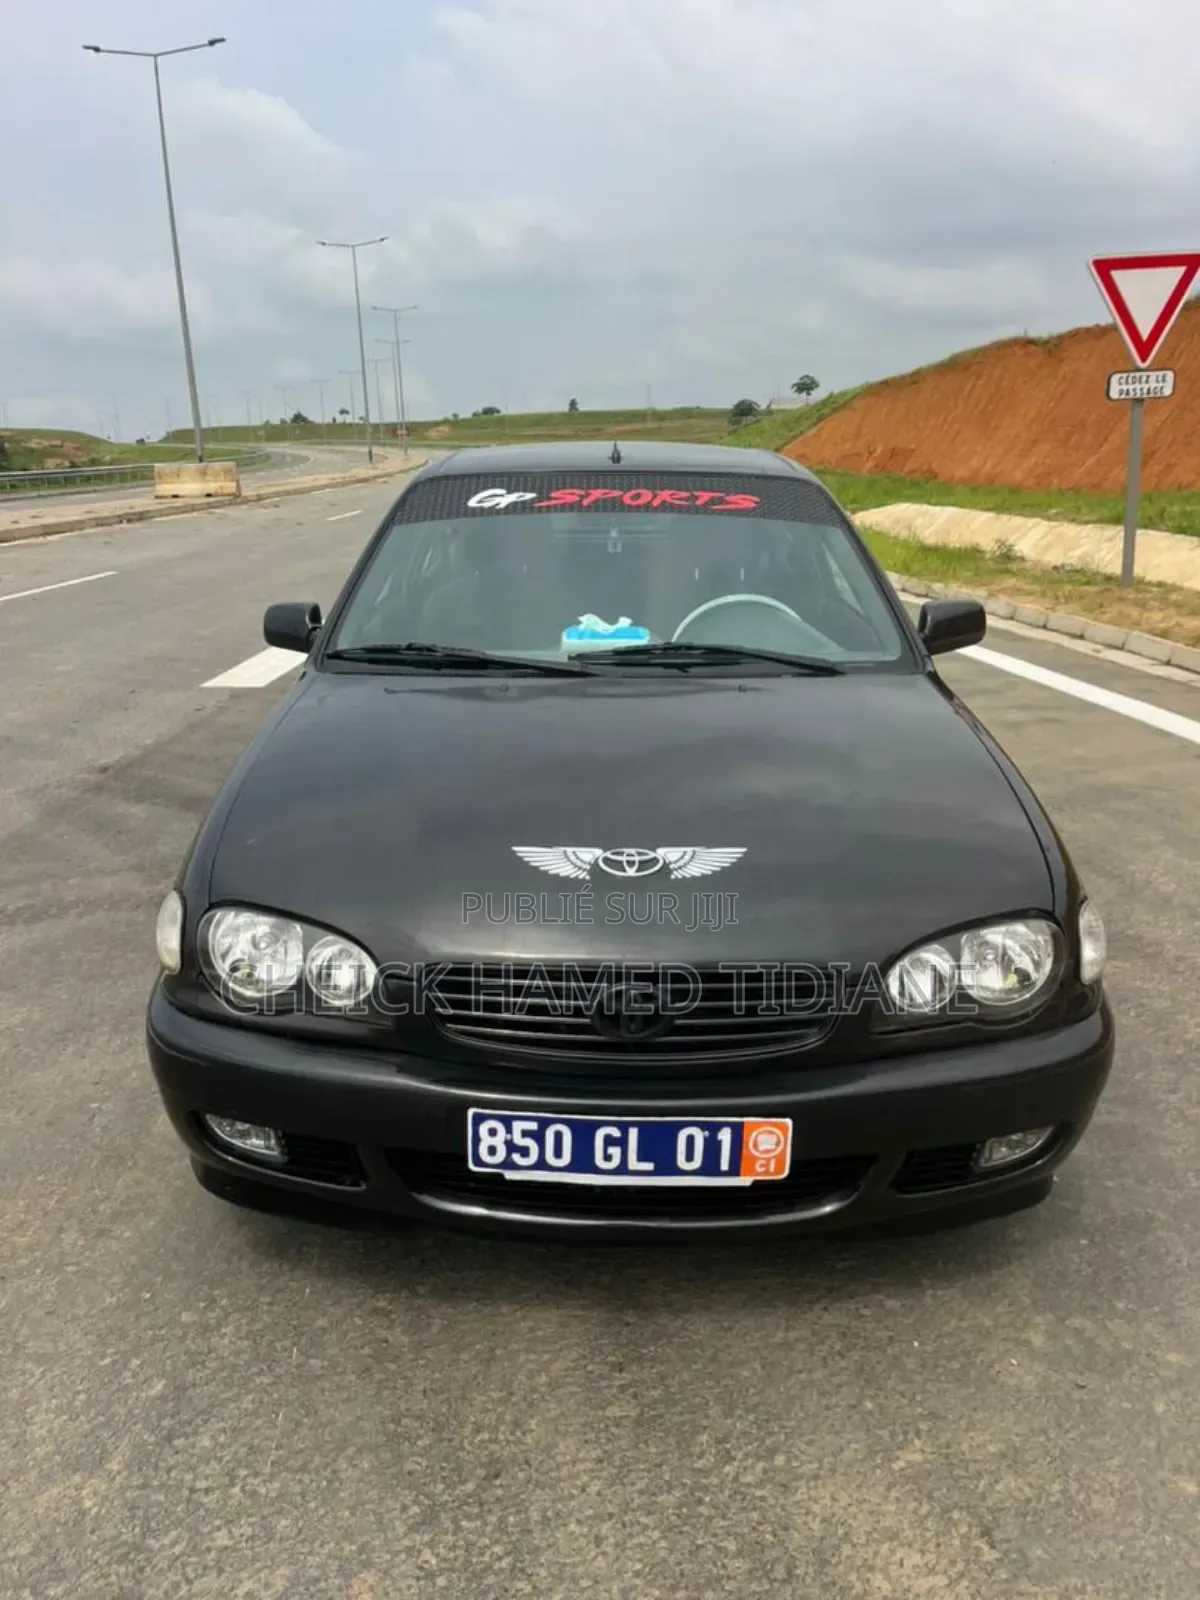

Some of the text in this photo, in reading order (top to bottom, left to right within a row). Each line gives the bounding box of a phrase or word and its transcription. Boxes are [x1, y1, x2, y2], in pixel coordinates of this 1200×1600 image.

[1118, 373, 1167, 385] CÉDEZ LE
[1118, 385, 1164, 397] PASSAGE
[533, 489, 761, 511] SPORTS
[478, 1119, 732, 1172] 850 GL 01
[755, 1159, 776, 1173] CI
